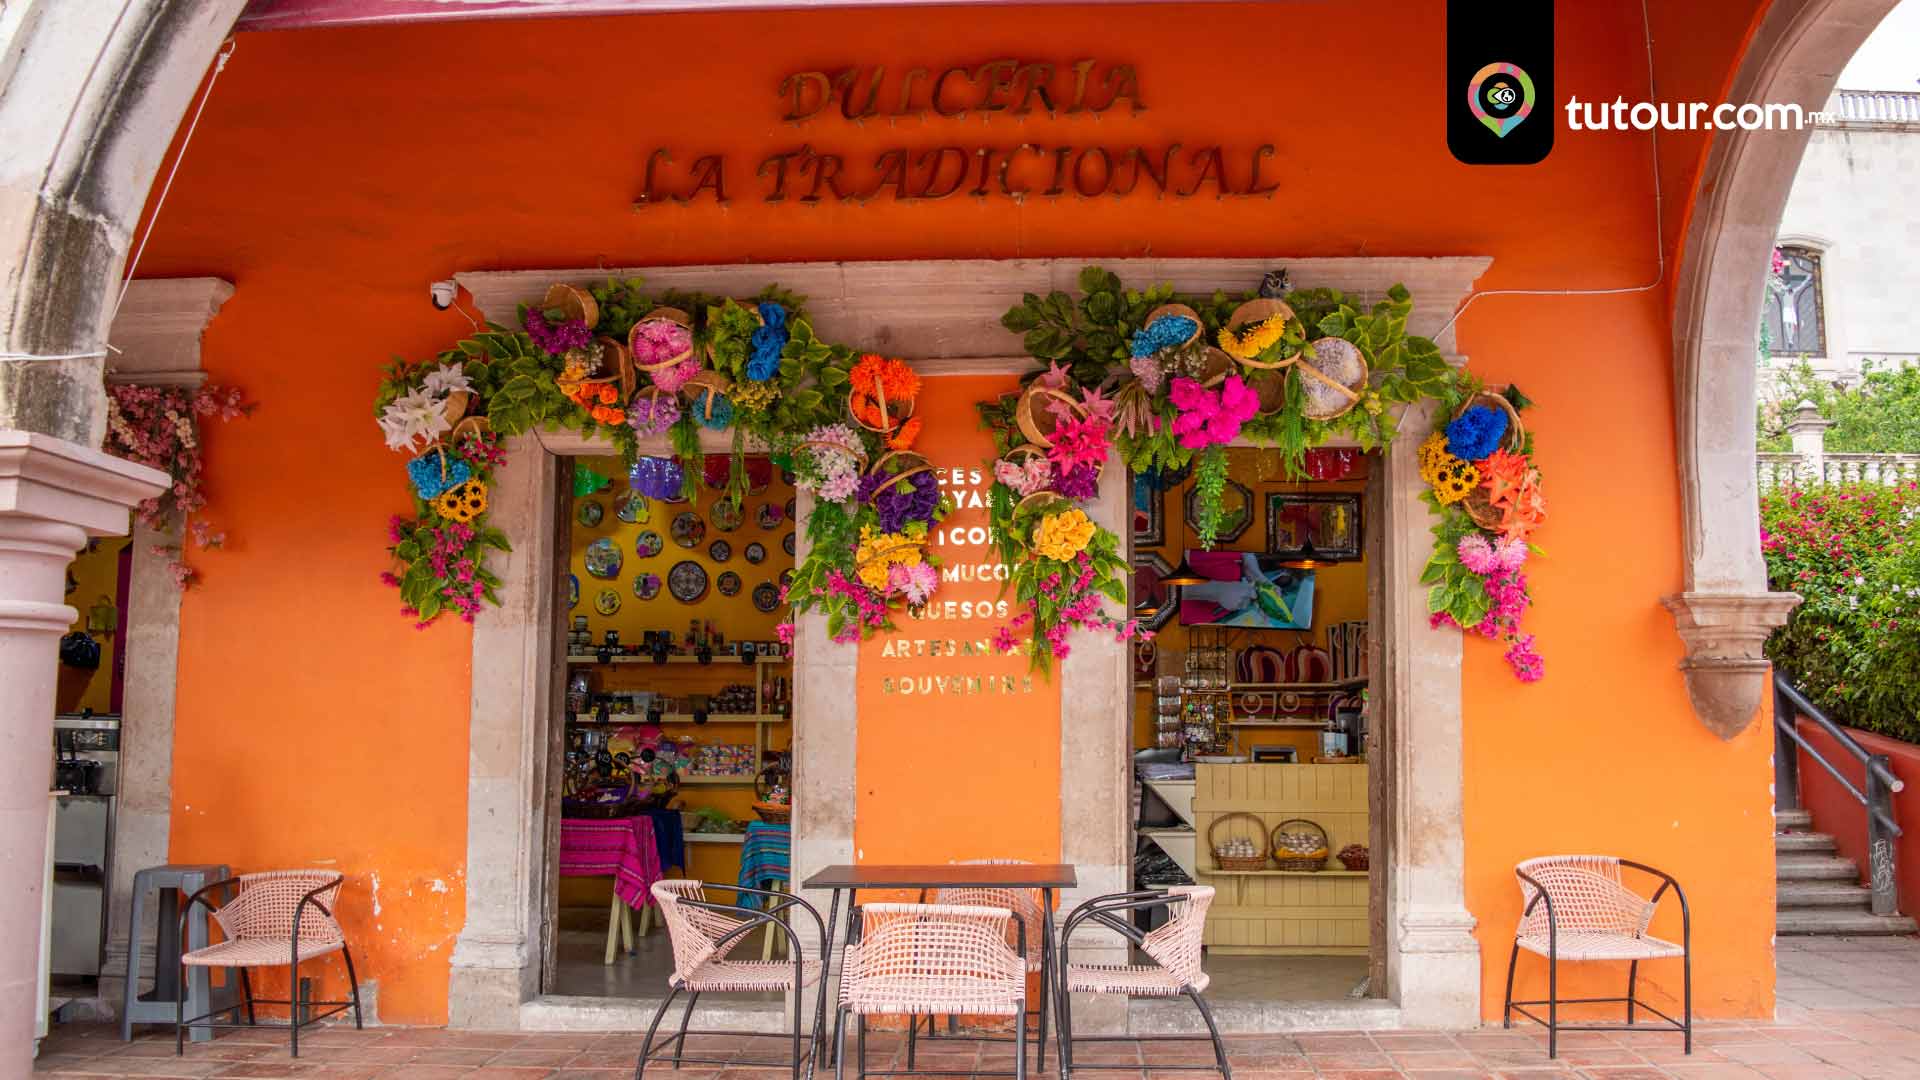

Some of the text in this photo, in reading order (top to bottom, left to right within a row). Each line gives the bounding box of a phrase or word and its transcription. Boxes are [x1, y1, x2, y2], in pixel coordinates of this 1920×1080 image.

[632, 143, 1281, 203] LA TRADICIONAL
[881, 639, 1035, 657] ARTESANAS
[883, 675, 1033, 695] SOUVENIRS
